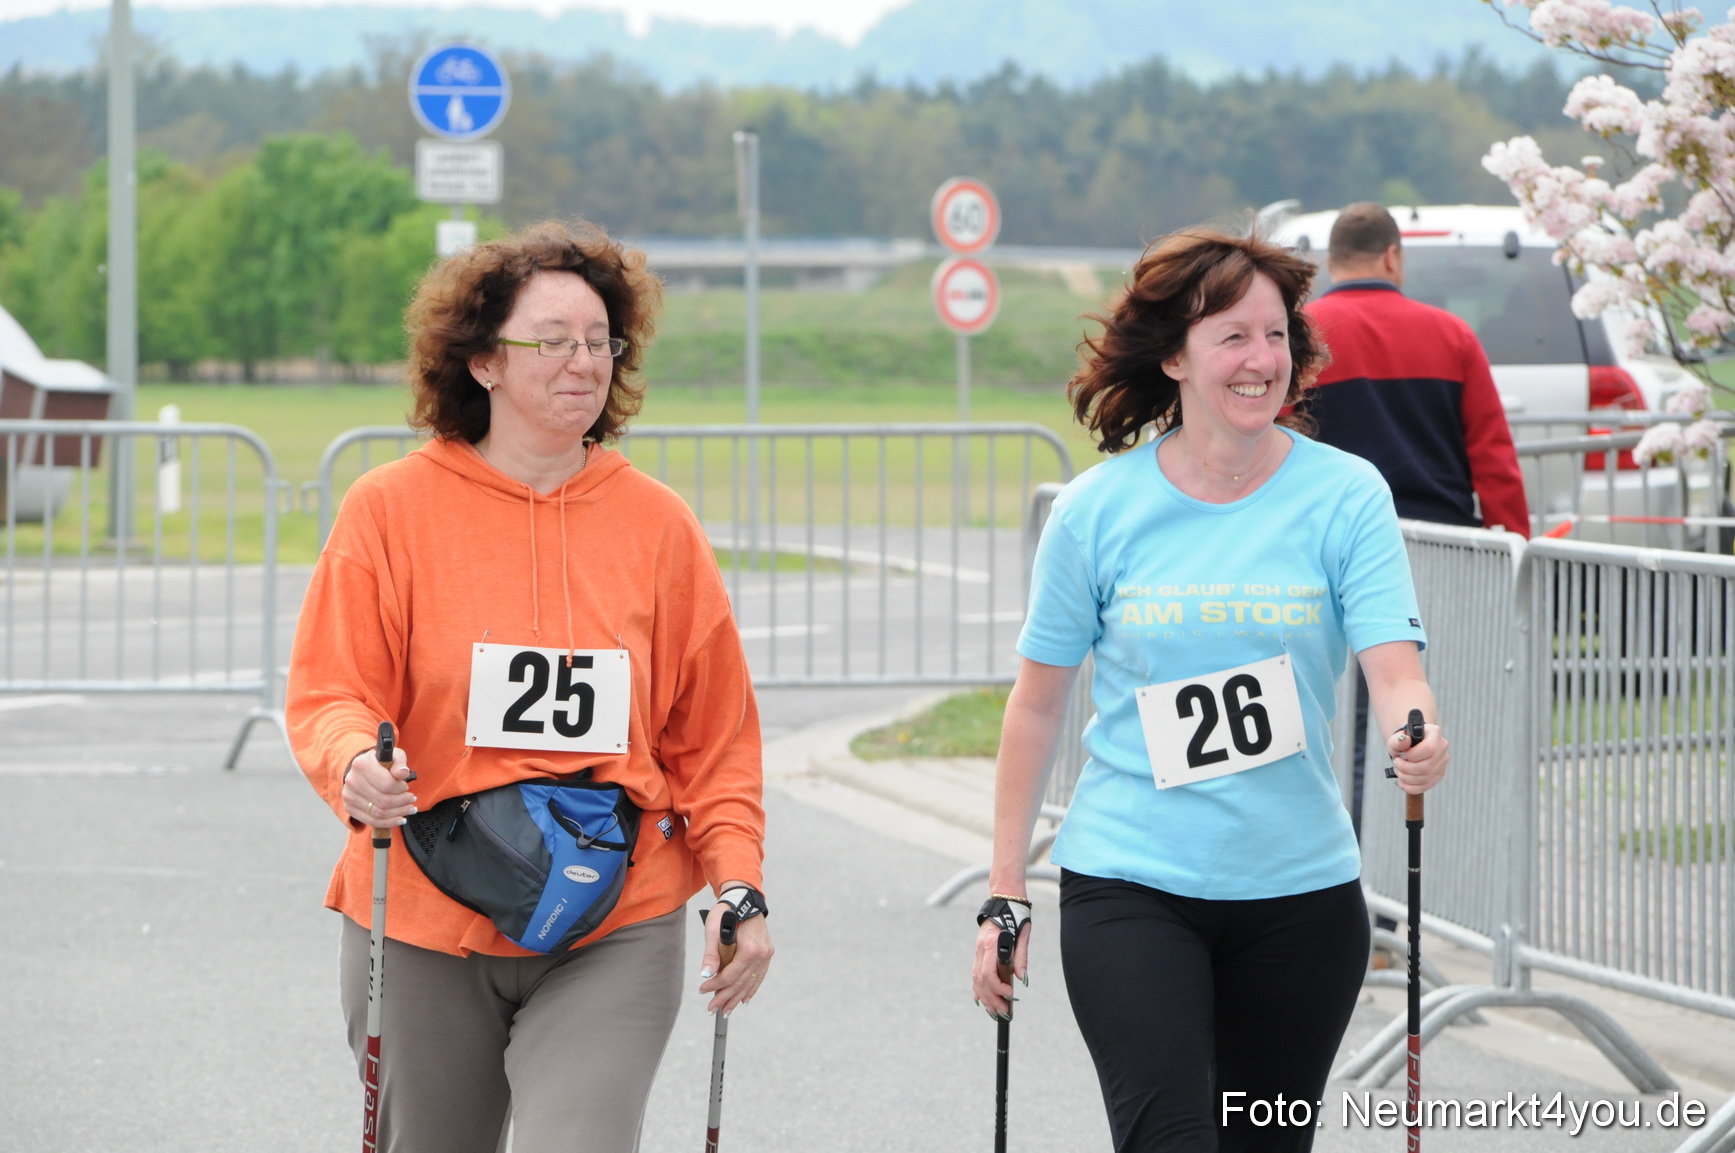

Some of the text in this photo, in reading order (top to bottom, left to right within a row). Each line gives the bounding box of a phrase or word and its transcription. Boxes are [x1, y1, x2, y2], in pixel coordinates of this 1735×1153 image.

[950, 202, 984, 234] 60
[1117, 585, 1152, 598] ICH
[1158, 583, 1236, 597] GLAUB'
[1244, 583, 1282, 597] ICH
[1121, 601, 1323, 626] AM STOCK
[502, 651, 595, 738] 25
[1175, 673, 1272, 769] 26
[566, 869, 597, 879] deuter
[538, 904, 564, 941] NORDIC
[1003, 913, 1016, 941] LEK
